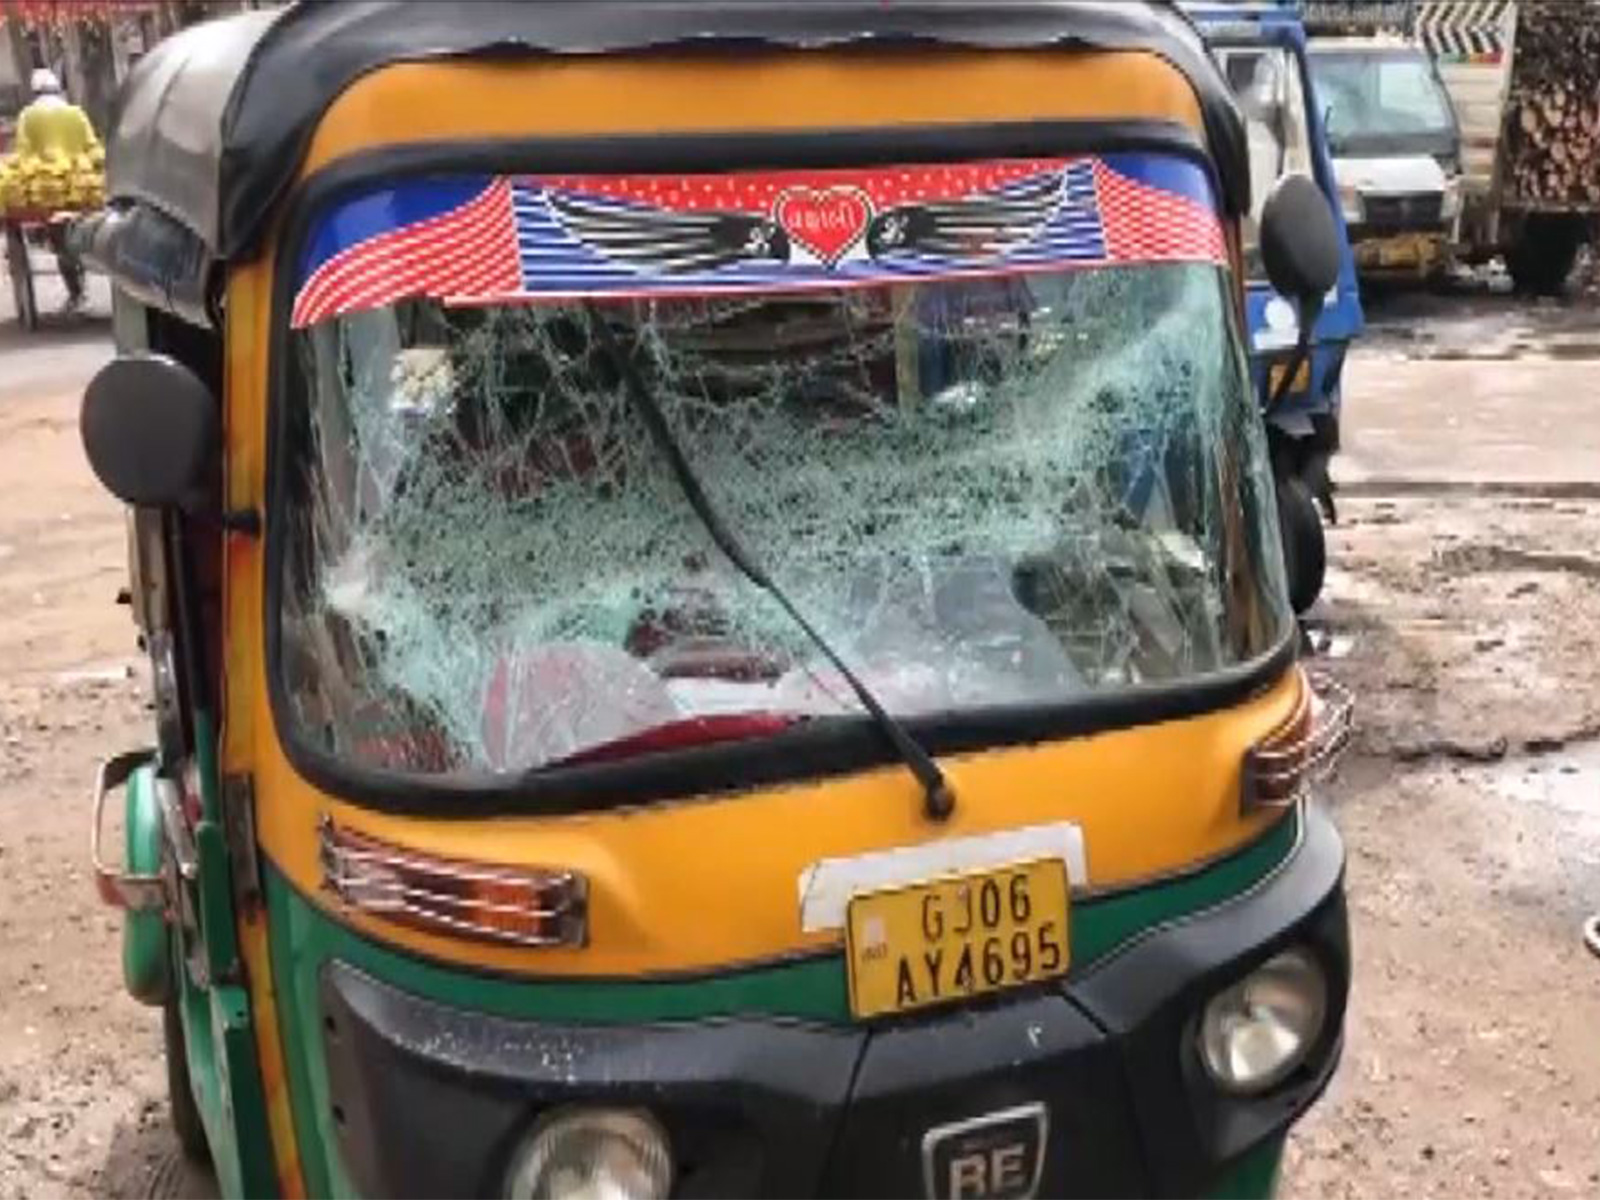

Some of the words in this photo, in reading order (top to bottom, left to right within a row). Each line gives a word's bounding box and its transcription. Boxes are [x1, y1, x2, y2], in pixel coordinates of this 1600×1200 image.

[921, 874, 1031, 943] GJ06
[897, 922, 1061, 1006] AY4695
[950, 1144, 1026, 1200] RE
